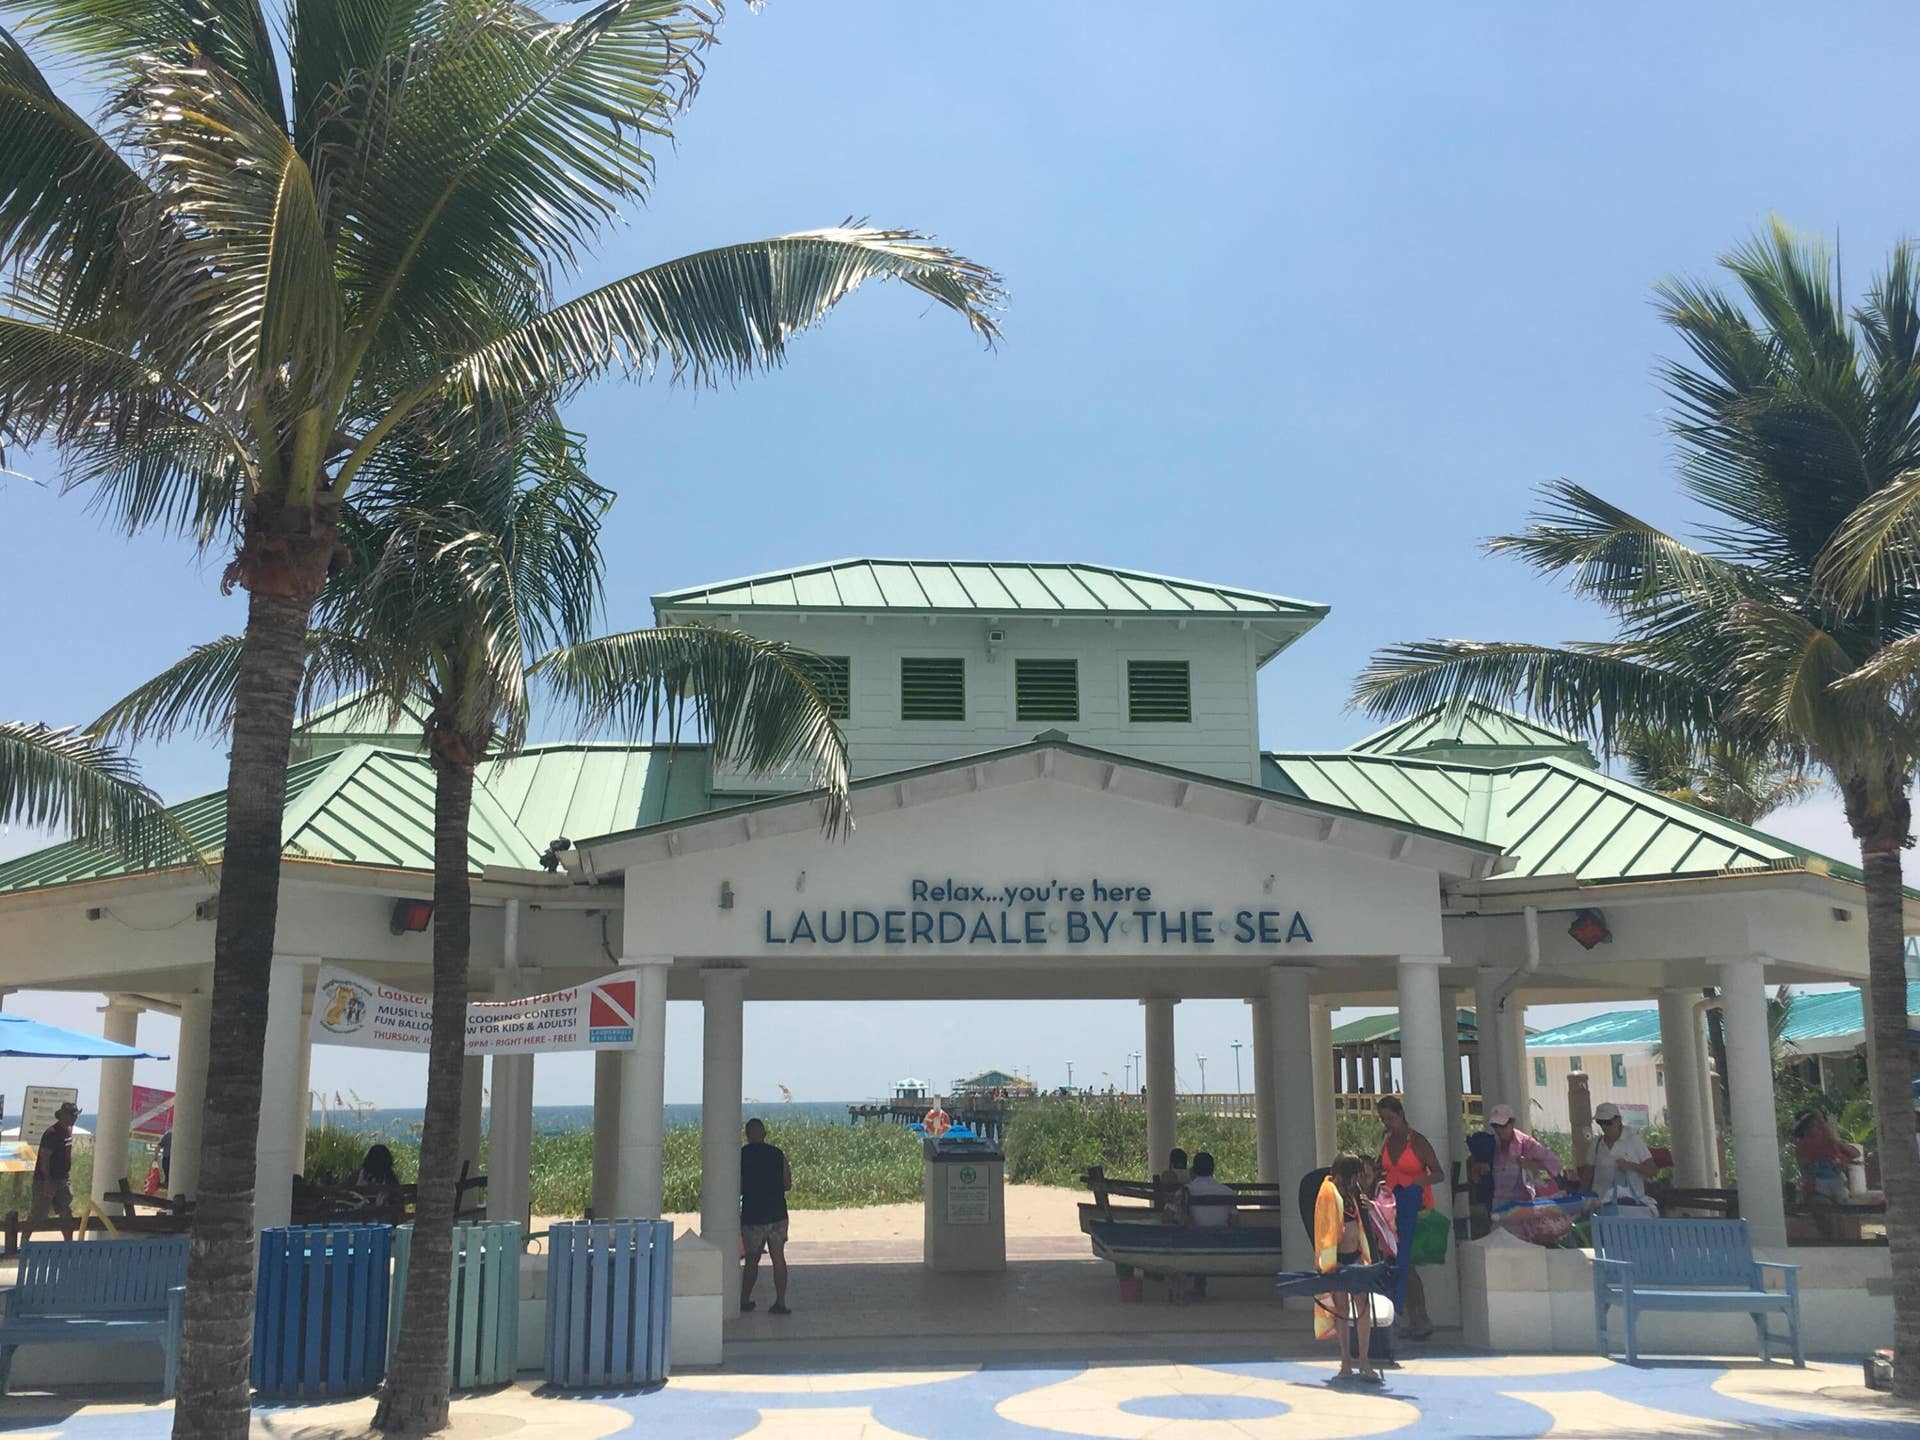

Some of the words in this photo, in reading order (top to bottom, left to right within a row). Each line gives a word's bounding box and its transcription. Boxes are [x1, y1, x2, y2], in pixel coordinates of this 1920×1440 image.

[1092, 878, 1152, 902] here
[765, 910, 1048, 944] LAUDERDALE
[1066, 910, 1119, 944] BY
[1132, 910, 1216, 944] THE
[1233, 910, 1314, 944] SEA
[533, 988, 578, 1005] Party!
[377, 1005, 418, 1018] MUSIC!
[468, 1014, 521, 1024] COOKING
[524, 1007, 578, 1019] CONTEST!
[374, 1015, 395, 1027] FUN
[398, 1019, 433, 1031] BALLO
[479, 1024, 500, 1034] FOR
[502, 1023, 525, 1033] KIDS
[526, 1022, 535, 1031] &
[537, 1018, 577, 1030] ADULTS!
[373, 1031, 421, 1044] THURSDAY,
[495, 1037, 522, 1047] RIGHT
[523, 1035, 546, 1045] HERE
[553, 1033, 577, 1043] FREE!
